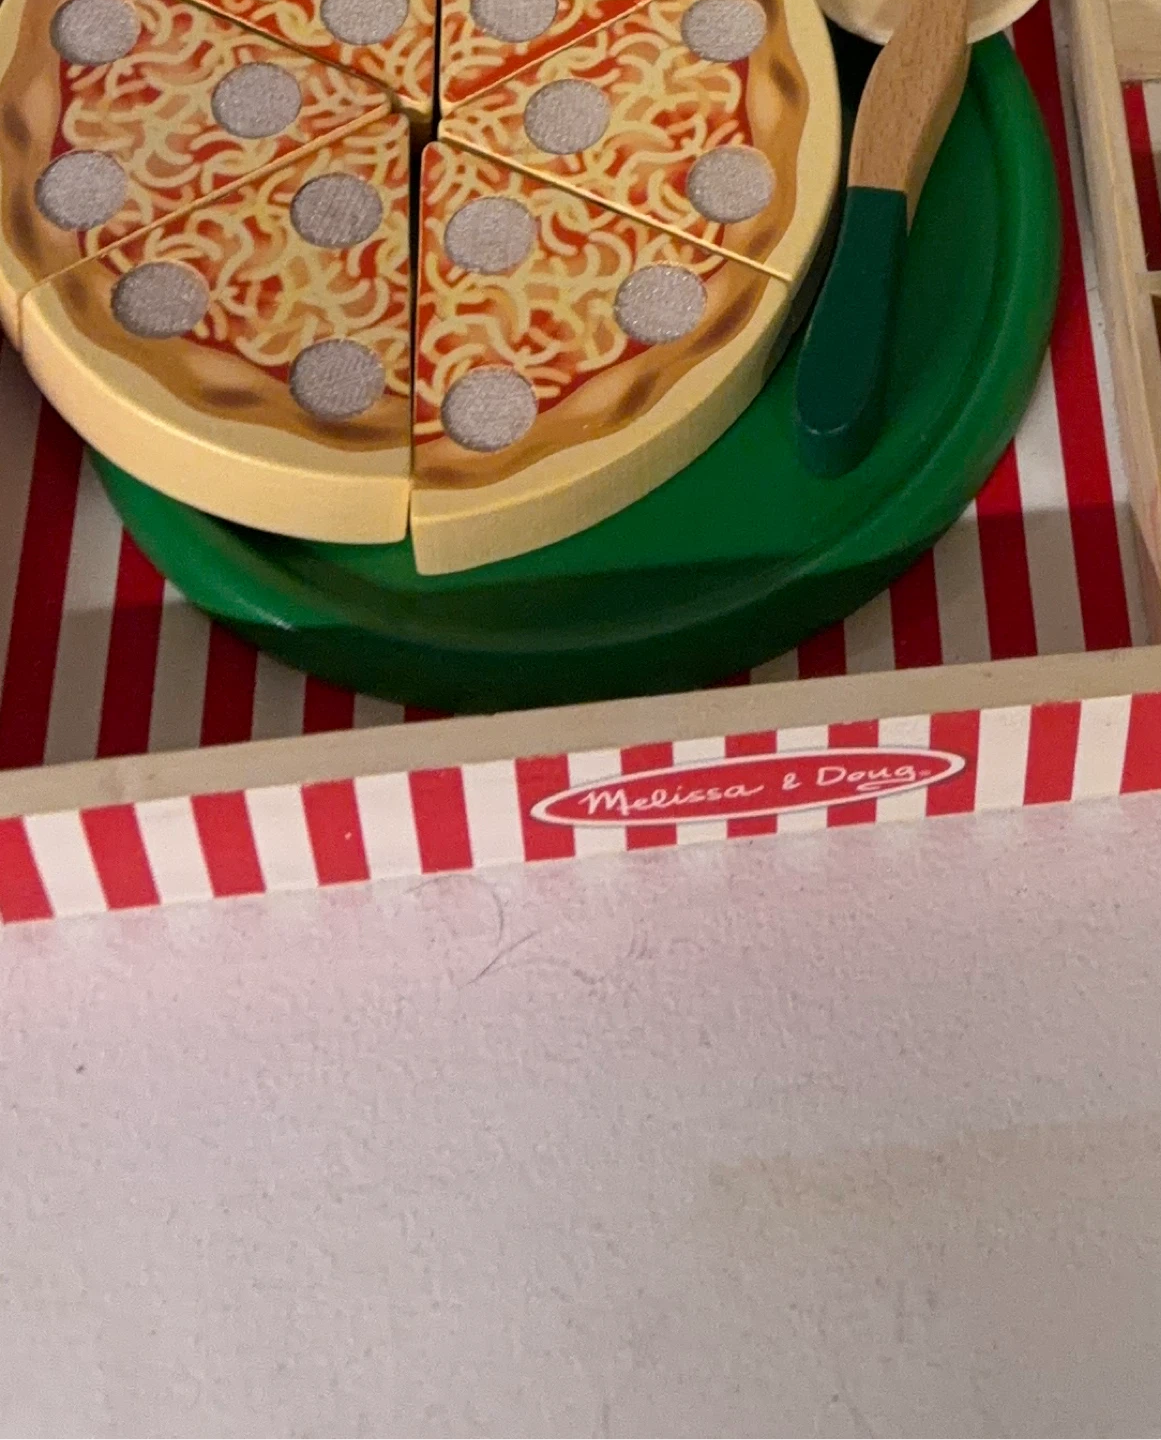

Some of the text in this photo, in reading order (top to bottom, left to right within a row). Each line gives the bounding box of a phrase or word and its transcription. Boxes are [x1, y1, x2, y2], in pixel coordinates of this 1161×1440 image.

[579, 765, 918, 816] Melissa & Doug
